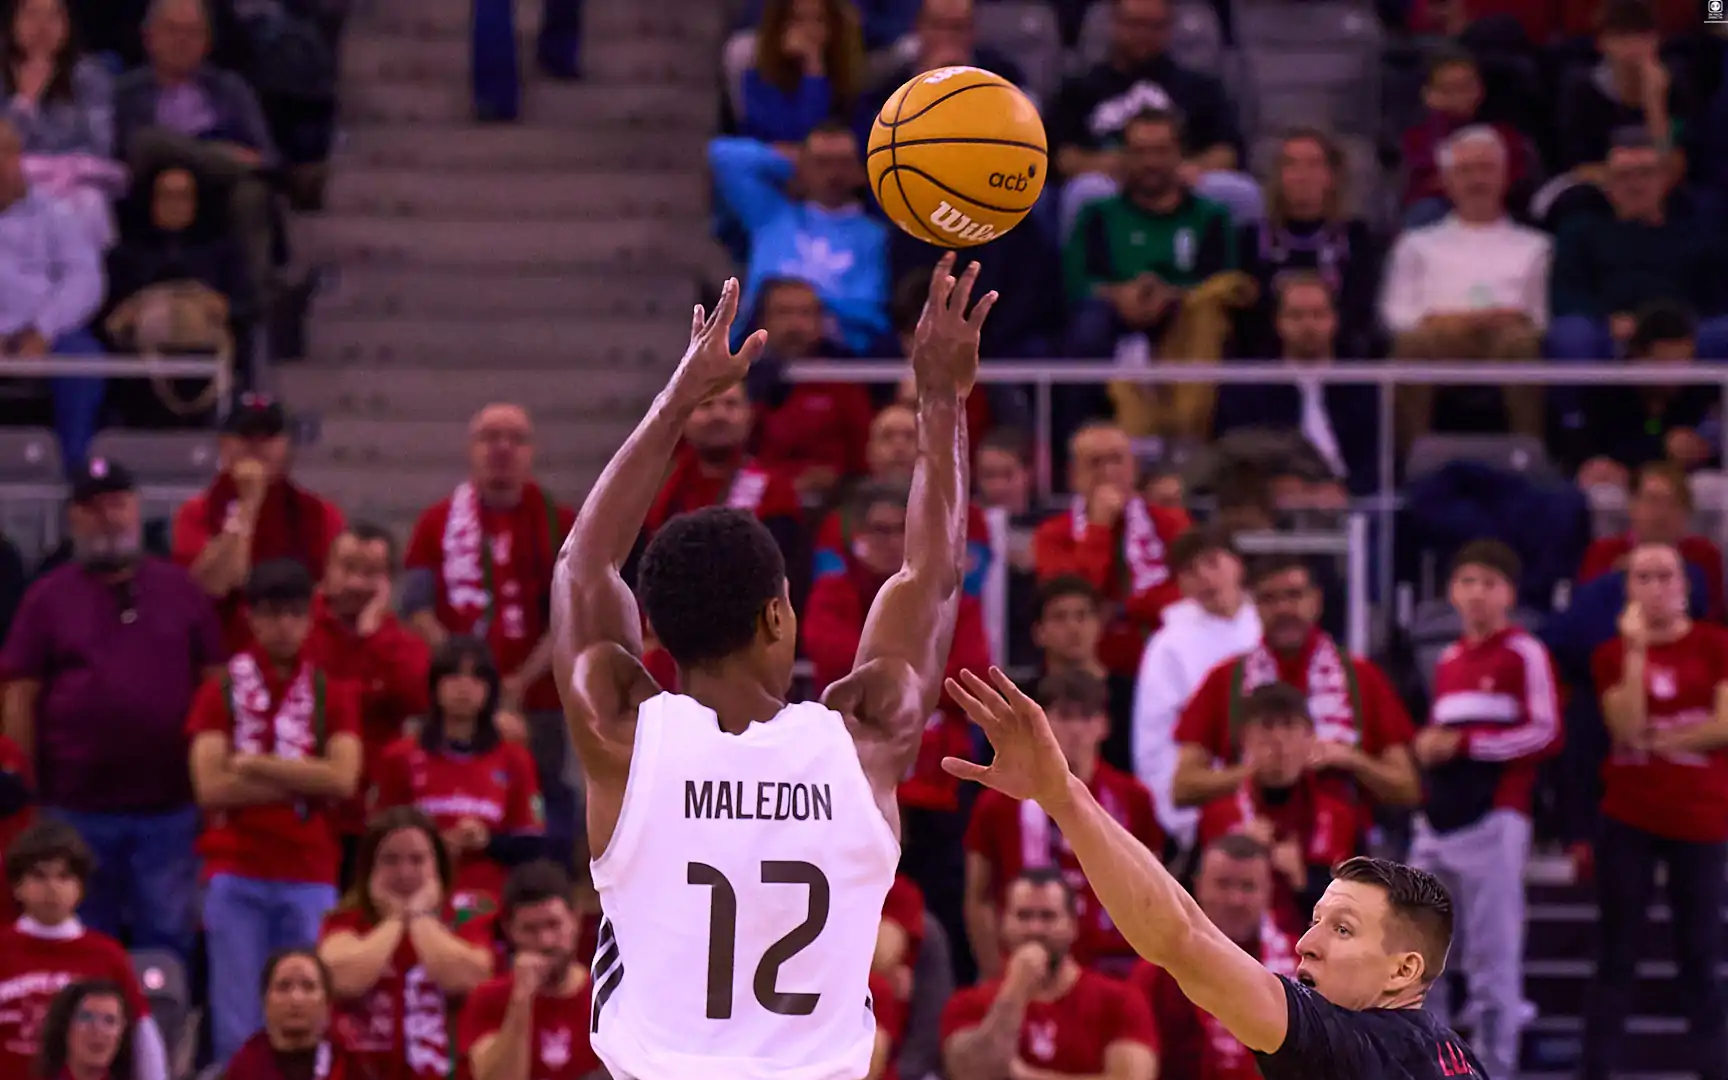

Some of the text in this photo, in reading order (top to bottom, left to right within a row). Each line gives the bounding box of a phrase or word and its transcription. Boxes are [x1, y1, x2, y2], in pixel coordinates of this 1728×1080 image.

[988, 171, 1028, 193] acb
[929, 200, 997, 242] Wils
[684, 780, 832, 820] MALEDON
[687, 860, 830, 1020] 12
[1436, 1040, 1475, 1077] LU
